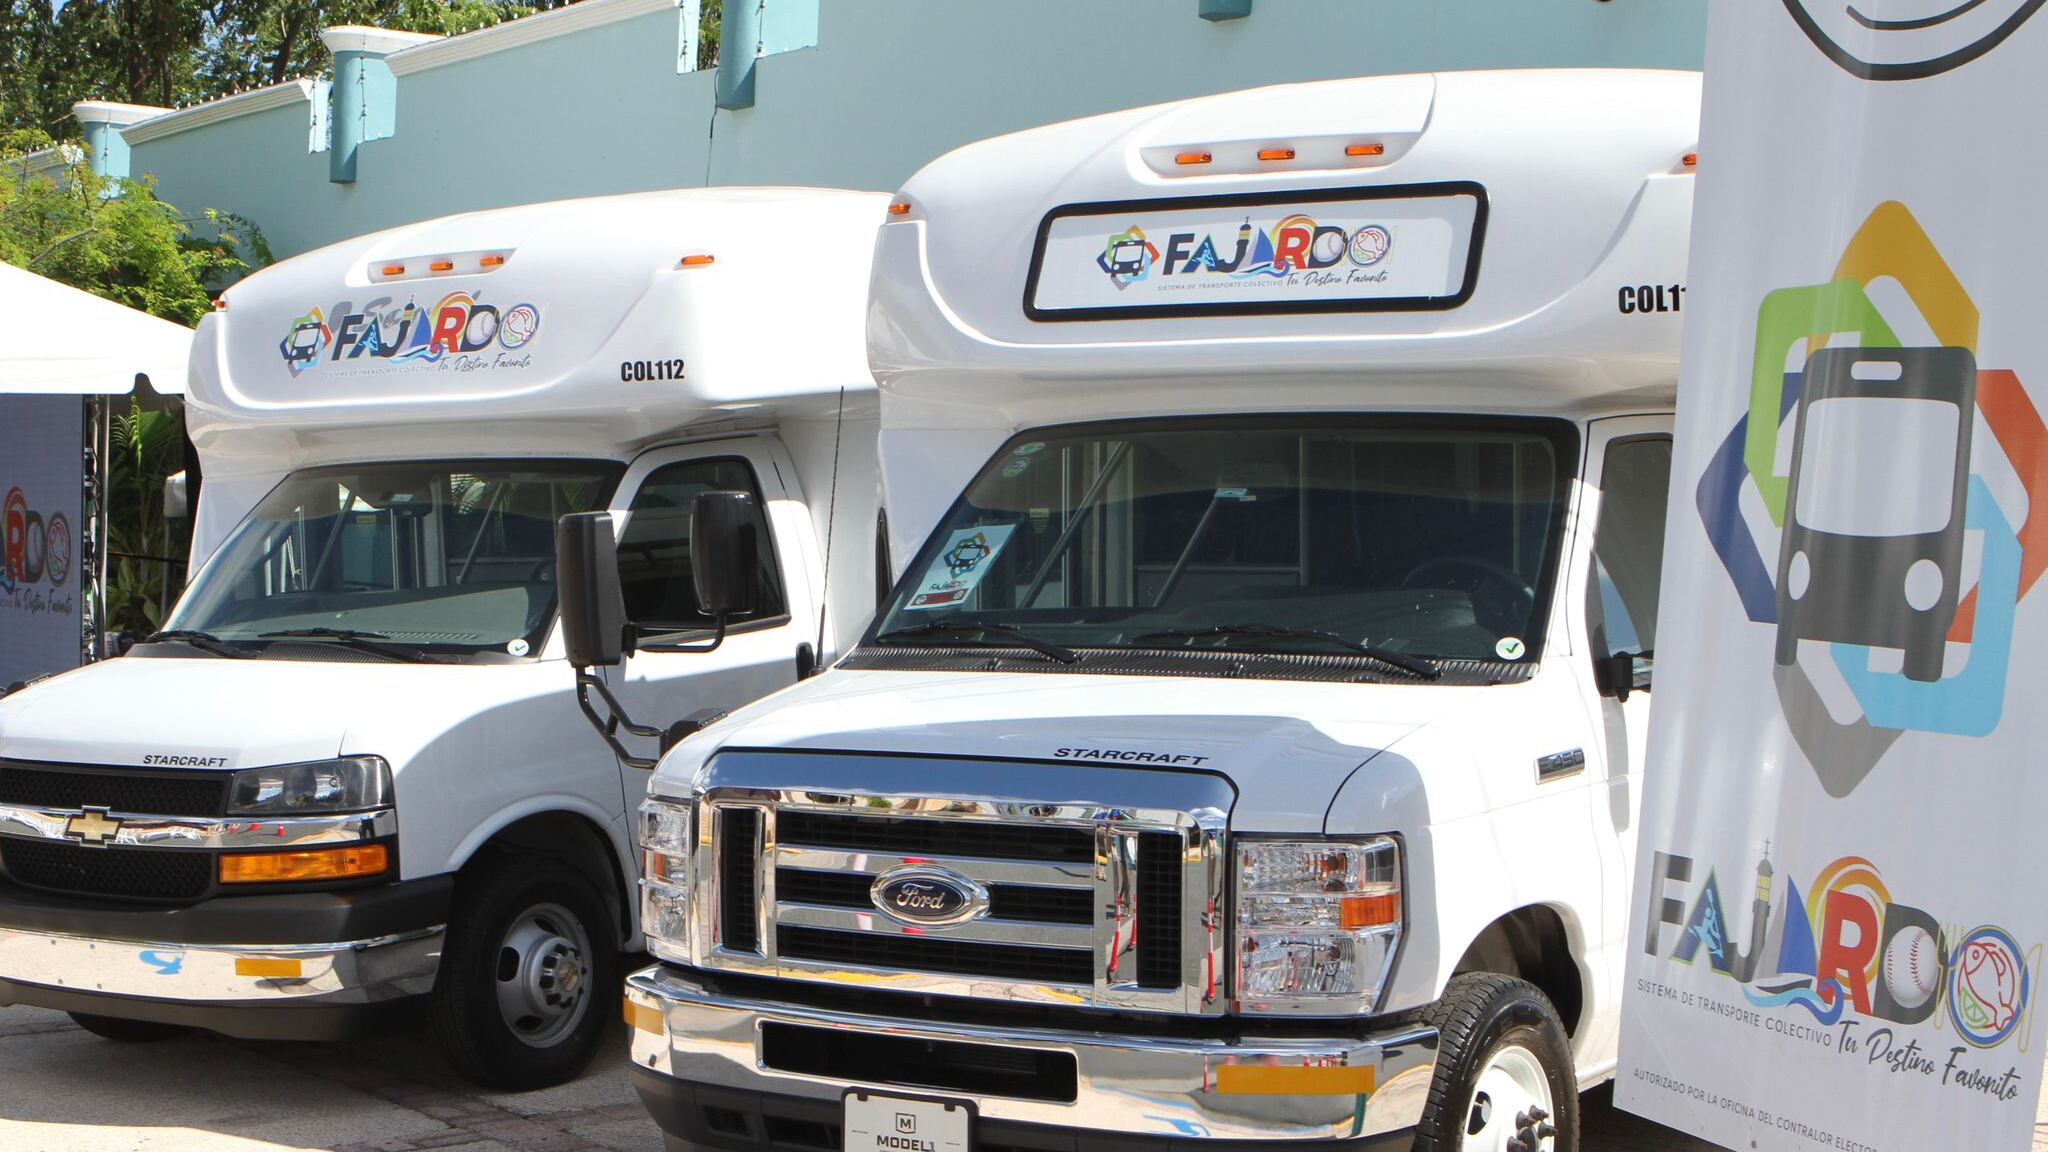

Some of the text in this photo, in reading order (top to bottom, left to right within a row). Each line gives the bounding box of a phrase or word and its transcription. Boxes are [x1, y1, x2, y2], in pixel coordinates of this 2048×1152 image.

[1163, 217, 1392, 275] FAJARDO
[1157, 284, 1186, 292] SISTEMA
[1187, 283, 1196, 291] DE
[1199, 281, 1242, 290] TRANSPORTE
[1243, 279, 1284, 288] COLECTIVO
[1304, 271, 1342, 287] Destino
[1346, 269, 1388, 285] Favorito
[1618, 284, 1686, 314] COL1
[331, 295, 541, 362] FAJARDO
[454, 355, 489, 372] Destino
[492, 352, 532, 371] Favorito
[621, 359, 685, 381] COL112
[143, 754, 228, 767] STARCRAFT
[1054, 748, 1209, 765] STARCRAFT
[896, 883, 945, 910] Ford
[1645, 838, 2030, 1049] FAJARDO
[1637, 979, 2021, 1101] SISTEMA DE TRANSPORTE COLECTIVO Tu Destino Favorito
[1634, 1067, 1686, 1094] AUTORIZADO
[1688, 1086, 1705, 1102] POR
[1707, 1093, 1718, 1107] LA
[1720, 1098, 1755, 1119] OFICINA
[1758, 1110, 1774, 1126] DEL
[1777, 1117, 1833, 1147] CONTRALOR
[900, 1118, 912, 1129] M
